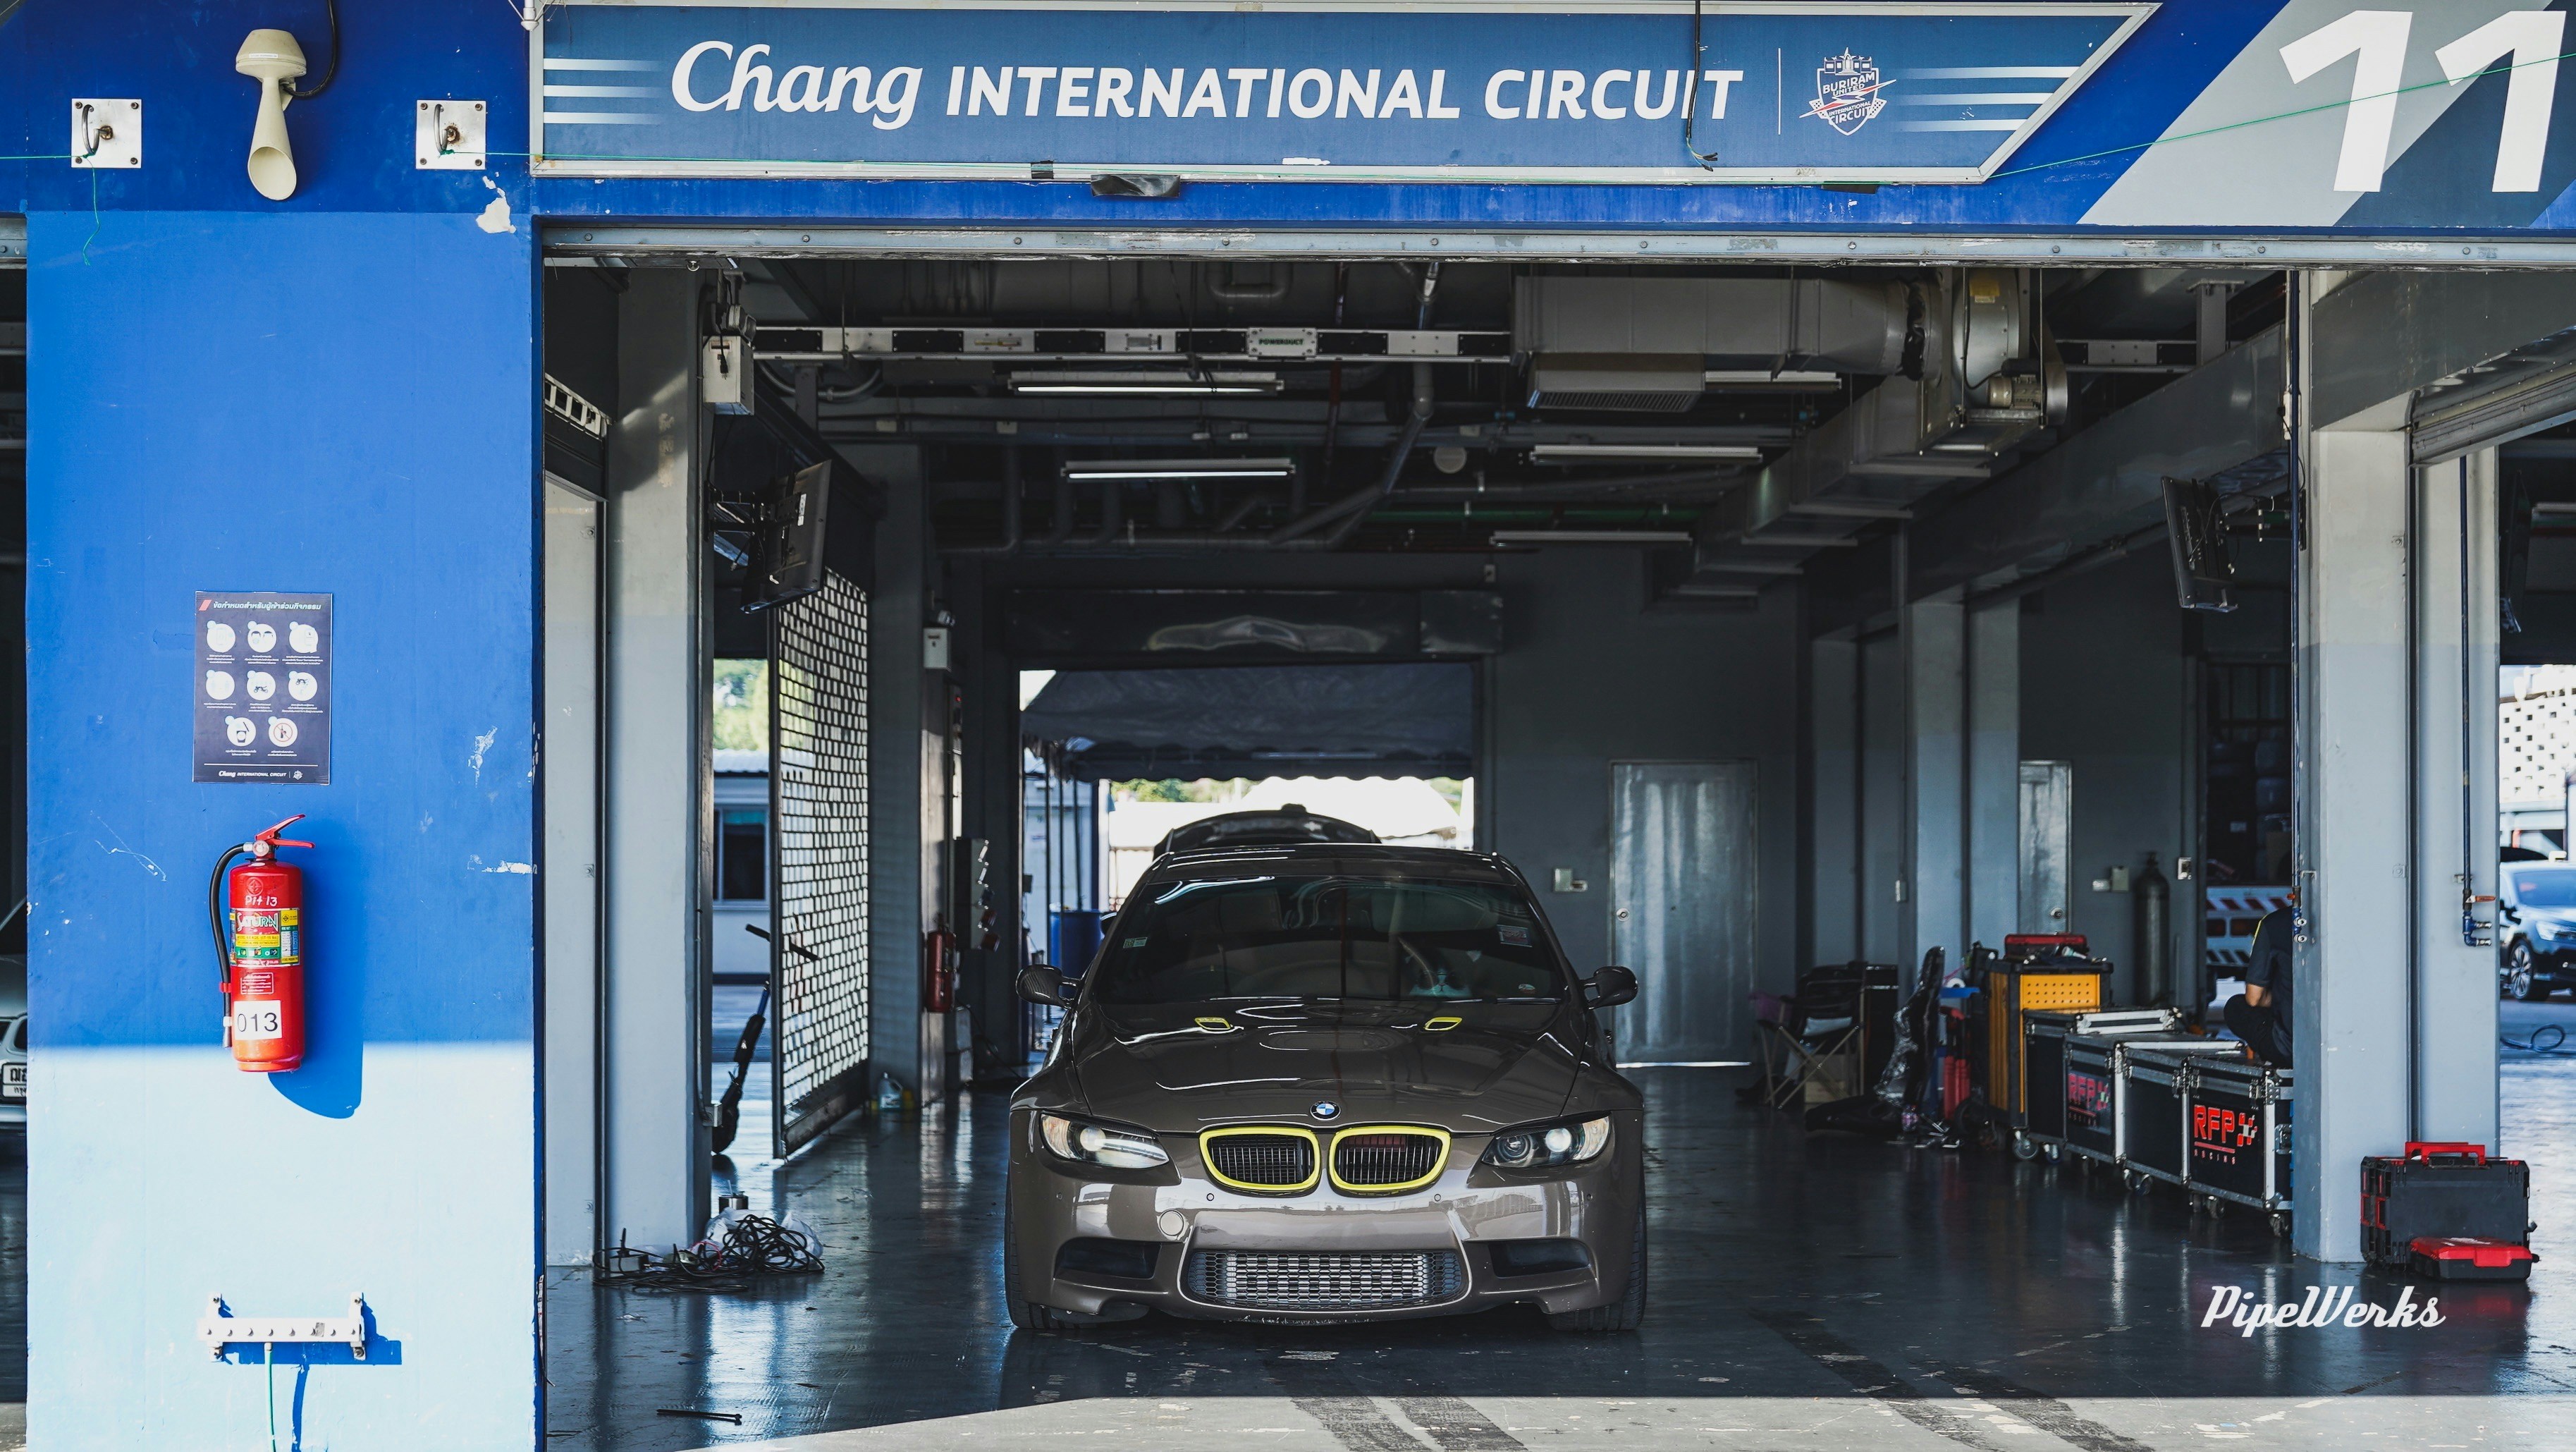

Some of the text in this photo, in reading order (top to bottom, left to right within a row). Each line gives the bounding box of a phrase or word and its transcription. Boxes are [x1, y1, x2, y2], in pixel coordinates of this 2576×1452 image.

[671, 40, 1744, 130] Chang INTERNATIONAL CIRCUIT
[1822, 72, 1875, 94] BURIRAM
[1833, 83, 1865, 97] UNITED
[1829, 101, 1872, 117] INTERNATIONAL
[2279, 11, 2566, 193] 11
[1829, 106, 1872, 126] CIRCUIT
[245, 895, 278, 907] Pit 13
[238, 1013, 278, 1032] 013
[2068, 1073, 2096, 1109] RFP
[2194, 1104, 2235, 1144] RFP
